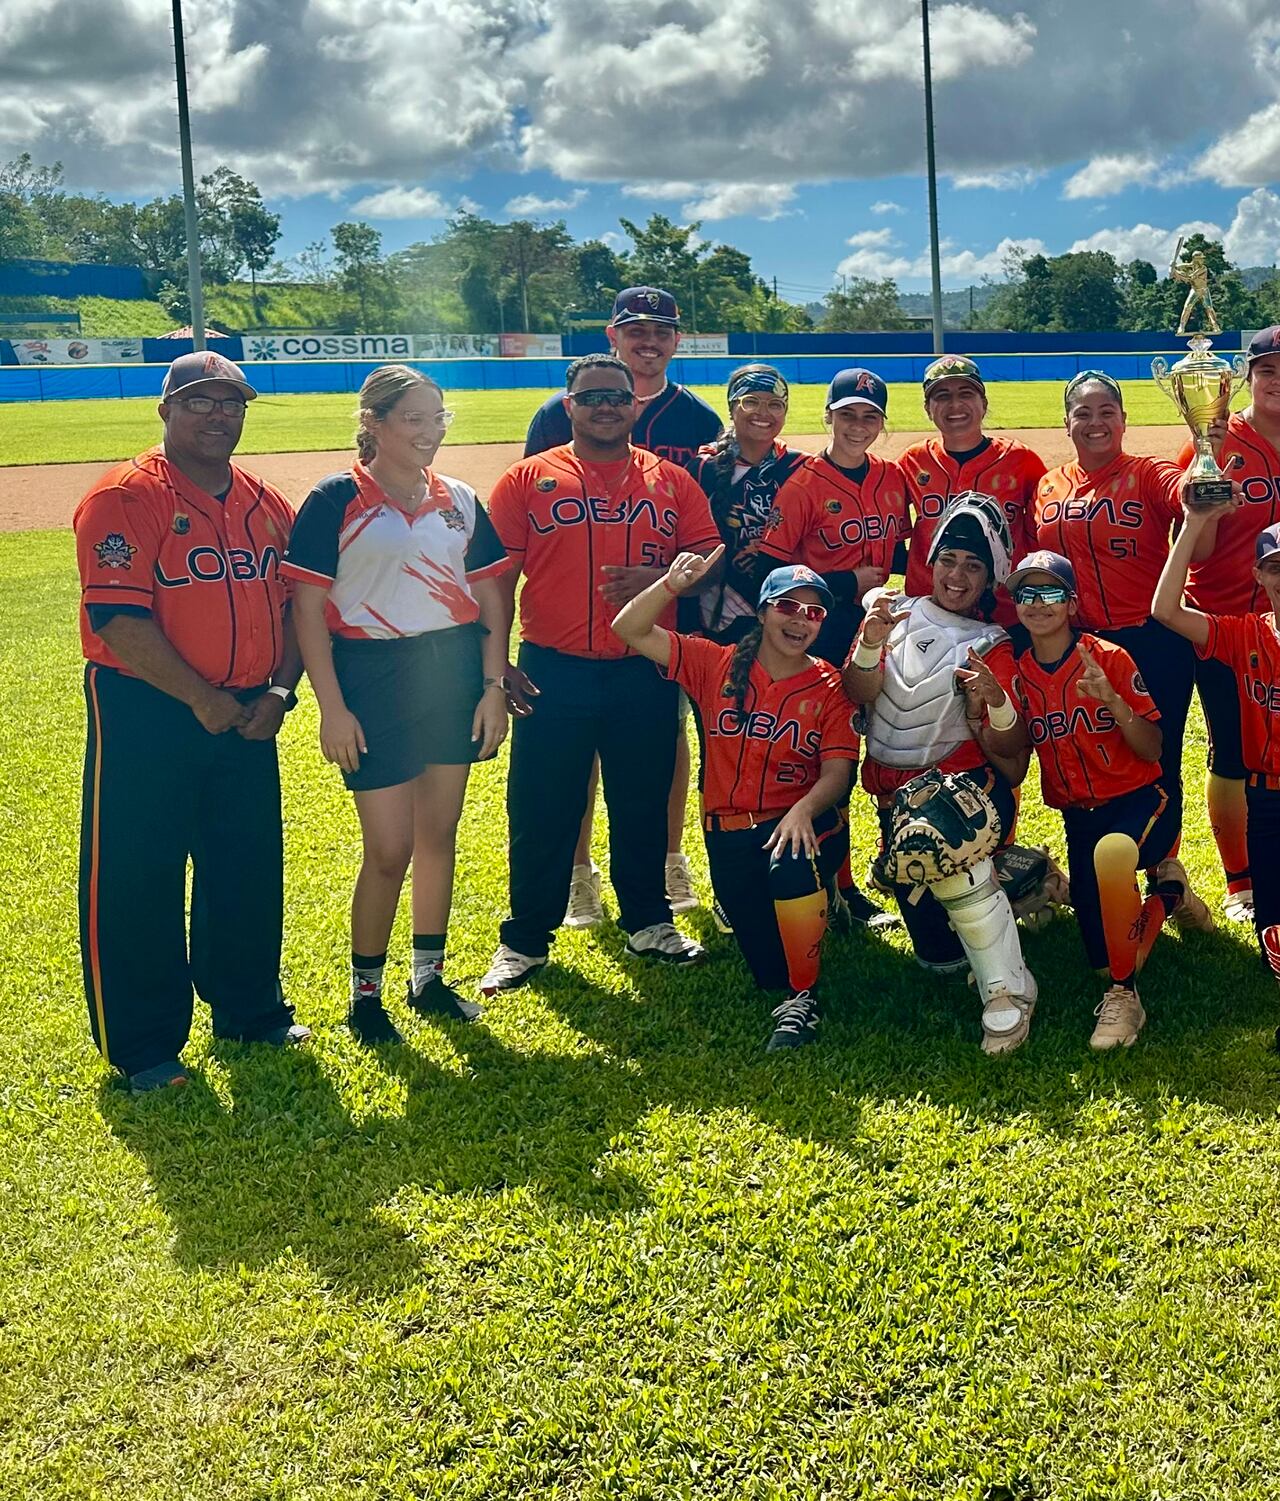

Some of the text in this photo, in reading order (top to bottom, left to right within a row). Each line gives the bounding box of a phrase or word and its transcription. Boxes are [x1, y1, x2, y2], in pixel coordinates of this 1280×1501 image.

[283, 337, 409, 355] cossma
[528, 497, 679, 538] LOBAS
[1041, 496, 1145, 529] OBAS
[817, 514, 900, 551] LOBA
[1109, 537, 1138, 559] 51
[154, 546, 286, 588] LOBA
[1029, 705, 1117, 744] OBAS
[1096, 744, 1111, 767] 1
[1003, 852, 1035, 865] SAVER
